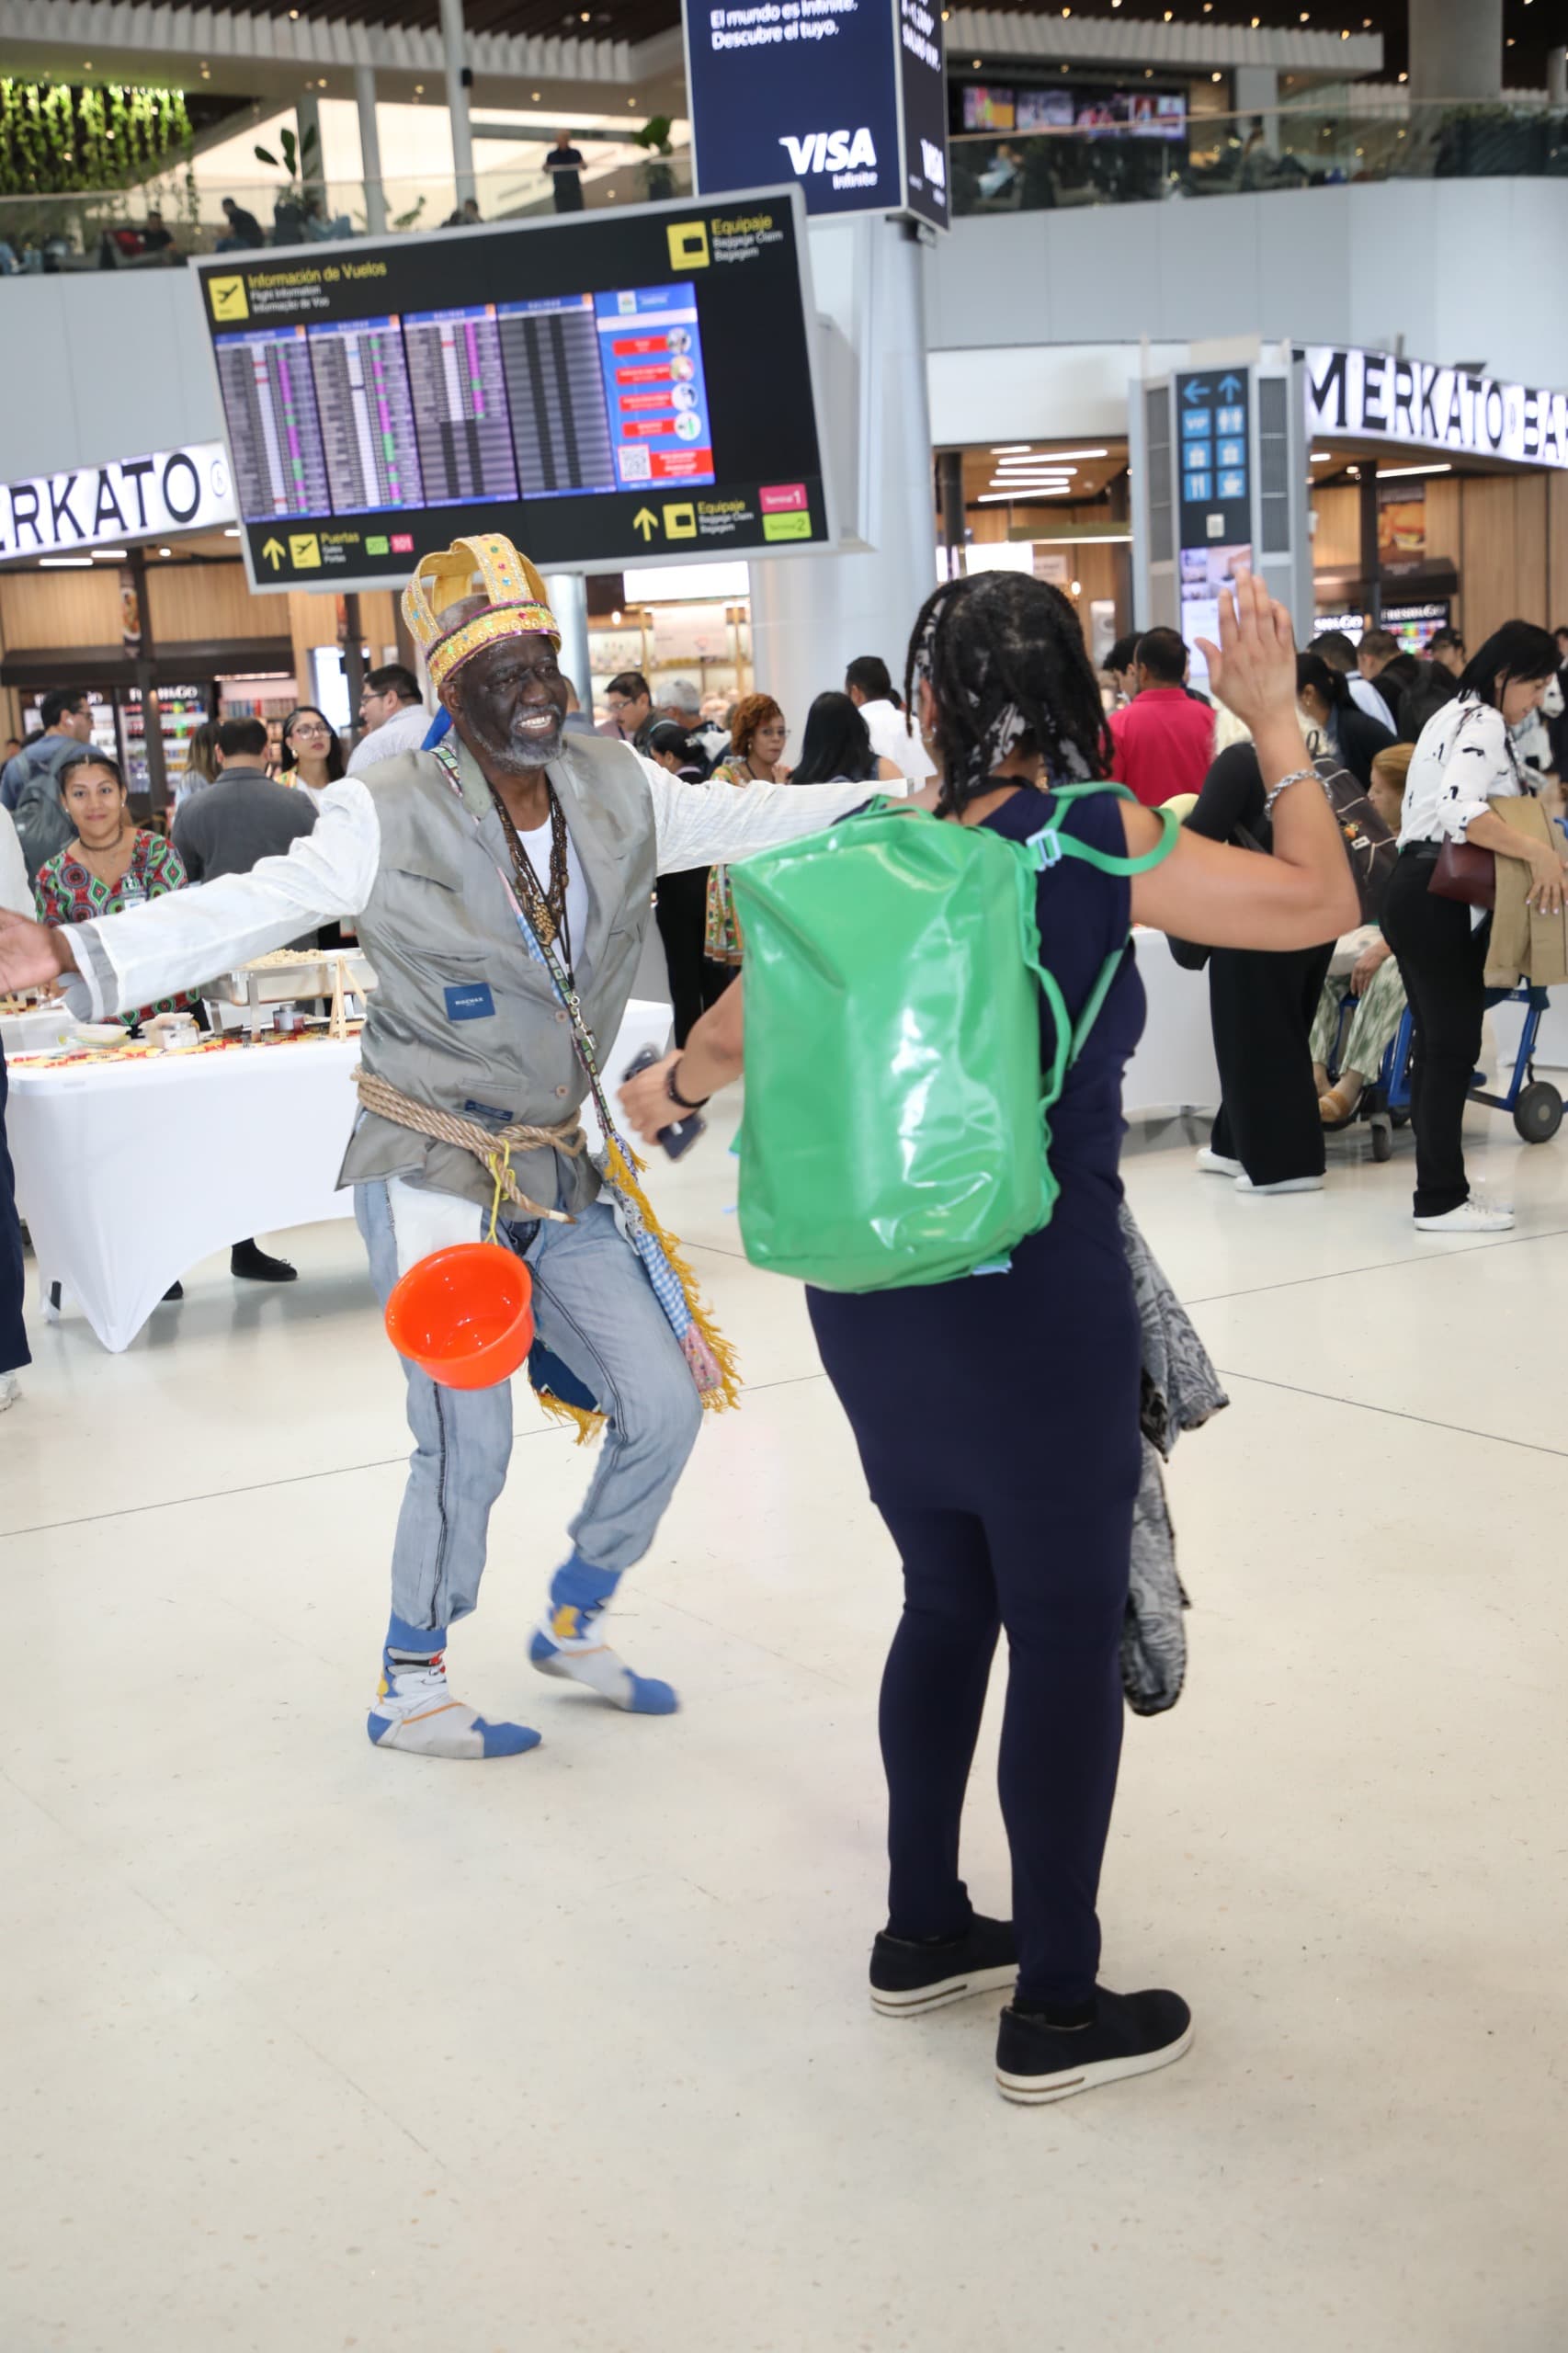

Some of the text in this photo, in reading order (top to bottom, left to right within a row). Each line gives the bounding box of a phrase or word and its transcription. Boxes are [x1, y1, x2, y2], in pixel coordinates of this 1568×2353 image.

[710, 9, 725, 29] El
[726, 4, 780, 28] mundo
[781, 3, 801, 20] es
[711, 26, 782, 50] Descubre
[783, 20, 799, 40] el
[778, 127, 877, 176] VISA
[832, 172, 878, 190] Infinite
[711, 214, 773, 236] Equipaje
[247, 261, 388, 290] Información de Vuelos
[1291, 349, 1504, 449] MERKATO
[0, 453, 200, 551] RKATO
[697, 499, 746, 516] Equipaje
[793, 489, 801, 506] 1
[795, 517, 806, 532] 2
[321, 531, 360, 545] Puertas
